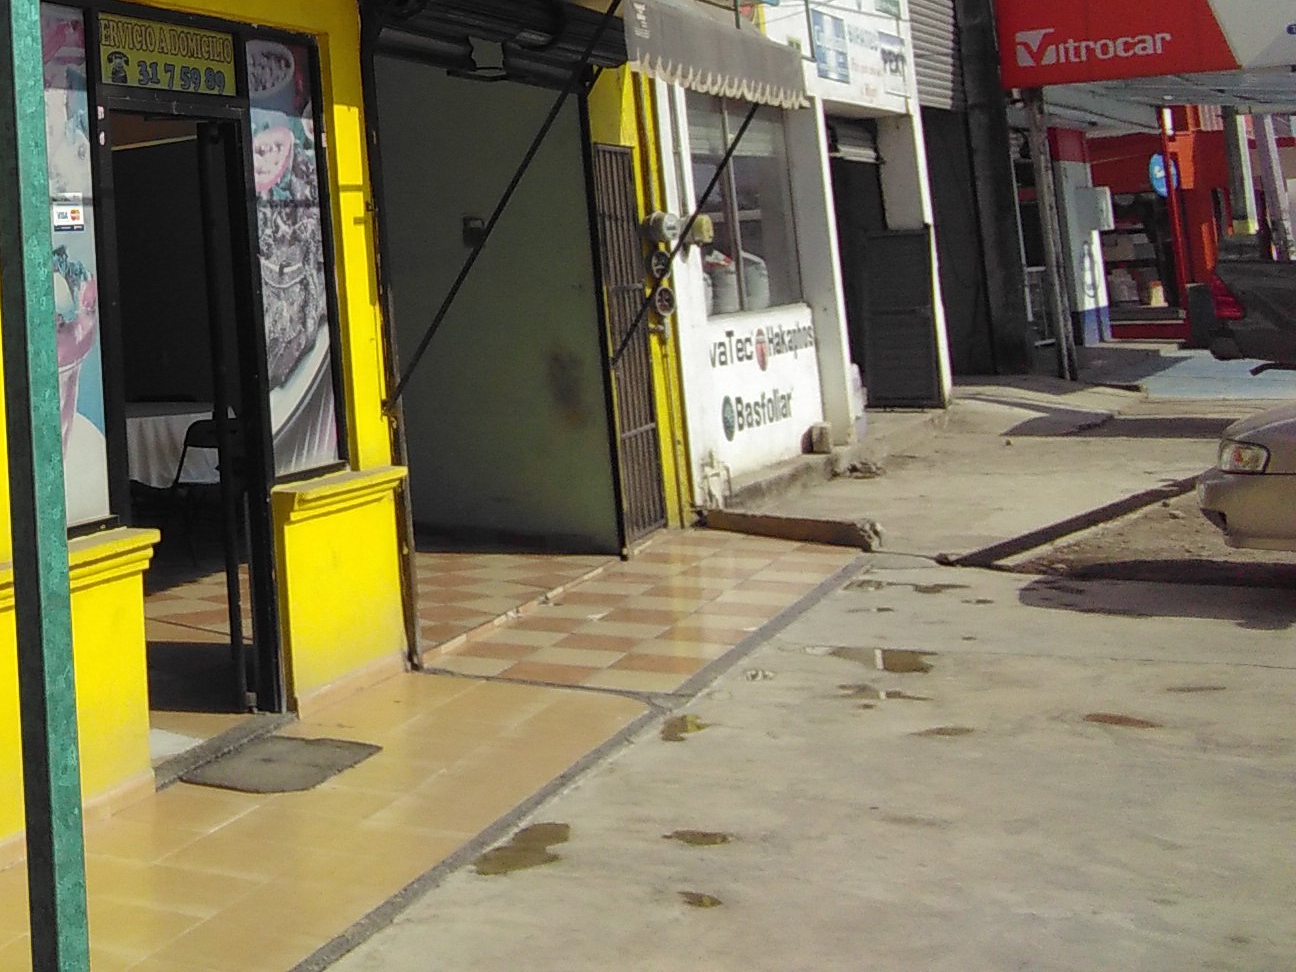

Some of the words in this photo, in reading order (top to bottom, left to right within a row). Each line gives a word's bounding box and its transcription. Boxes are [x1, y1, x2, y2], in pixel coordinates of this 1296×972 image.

[157, 27, 169, 54] A
[169, 29, 234, 64] DOMICILIO
[137, 60, 161, 85] 31
[164, 62, 175, 90] 7
[179, 66, 201, 92] 59
[204, 67, 225, 94] 89
[735, 388, 793, 432] Basfoliar
